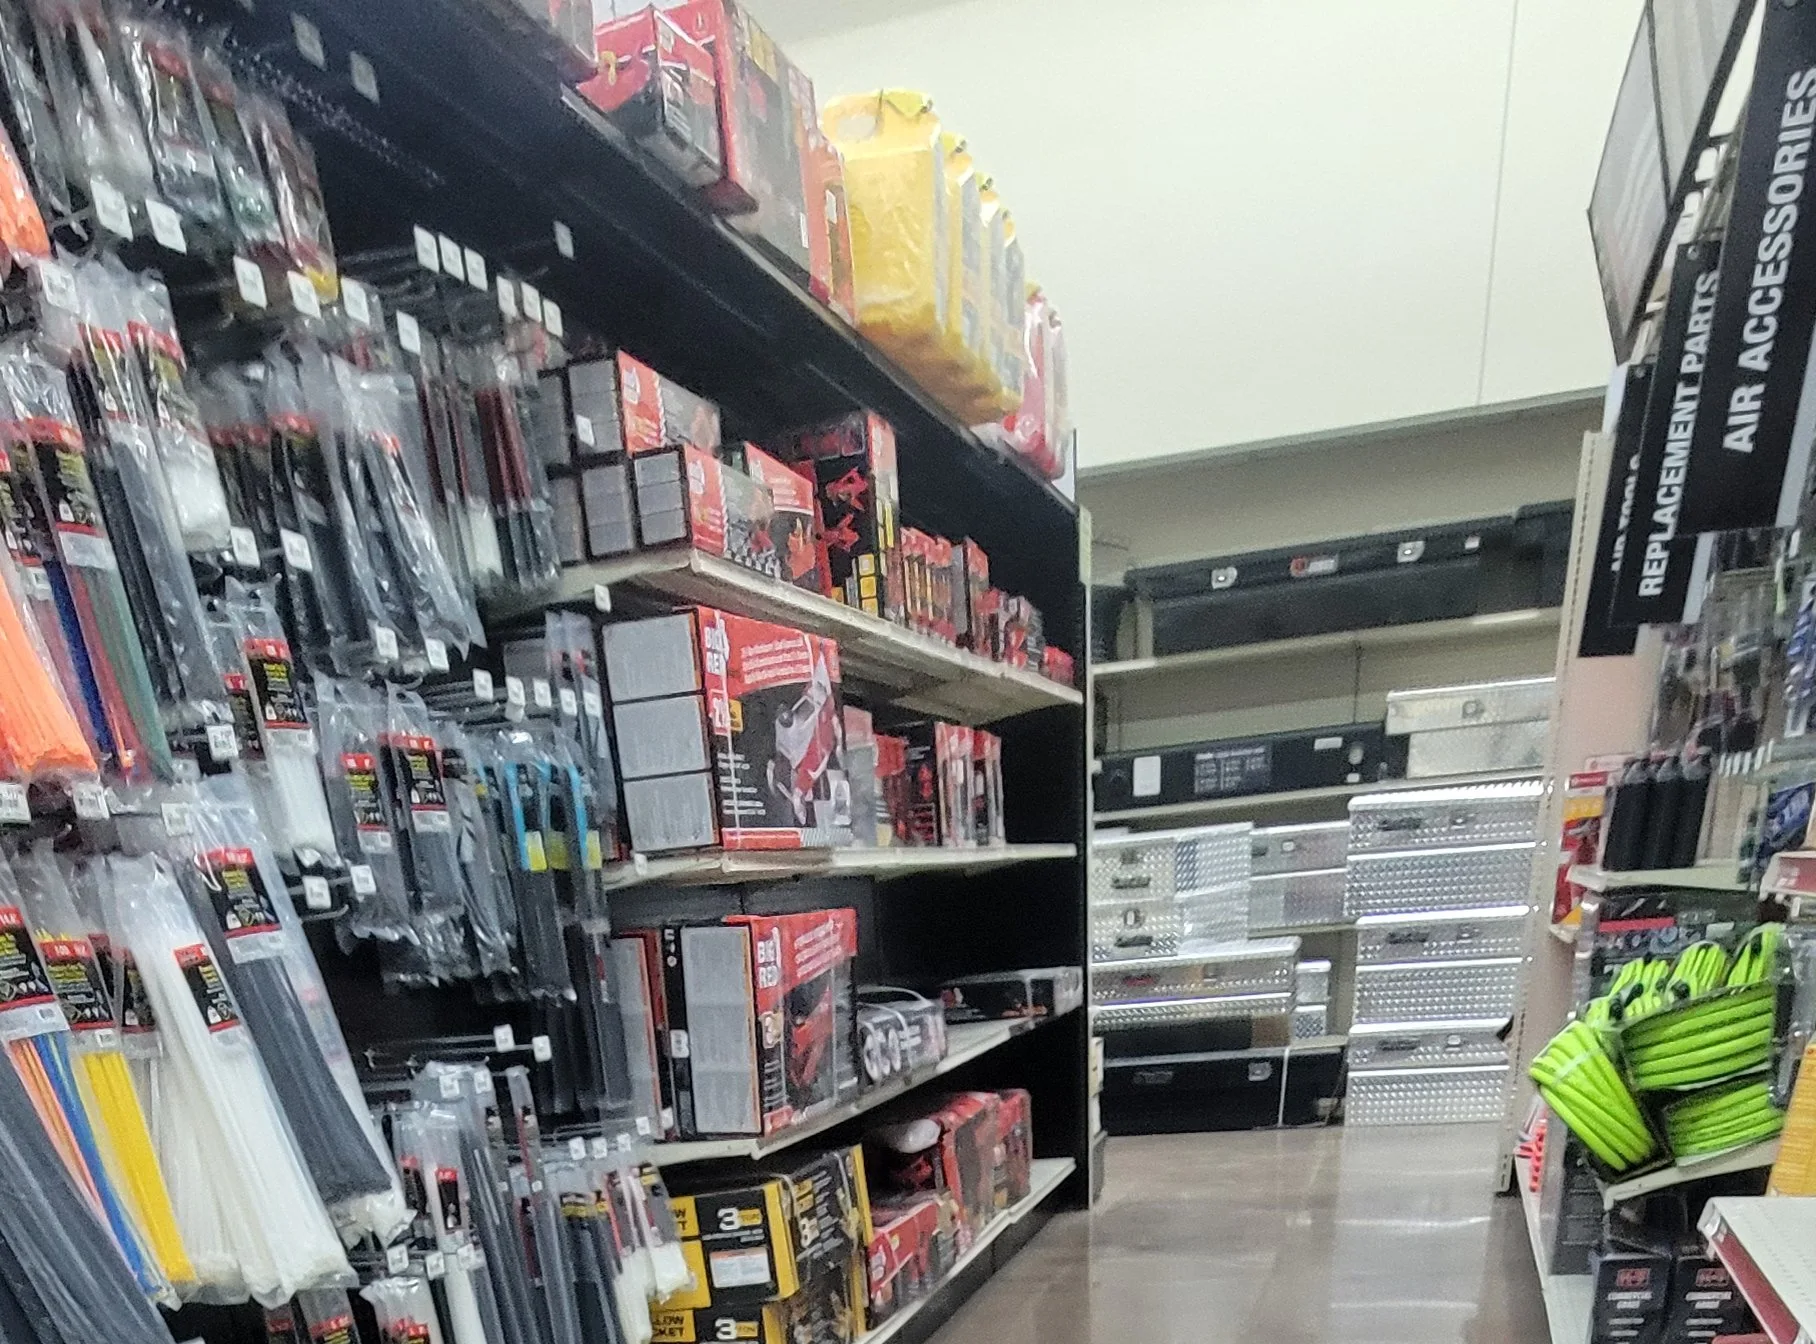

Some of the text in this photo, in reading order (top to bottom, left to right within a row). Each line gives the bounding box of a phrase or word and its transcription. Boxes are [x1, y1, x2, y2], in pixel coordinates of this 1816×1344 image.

[1722, 67, 1816, 454] AIR ACCESSORIES
[1637, 269, 1720, 597] REPLACEMENT PARTS
[717, 1207, 741, 1231] 3
[715, 1317, 738, 1340] 3
